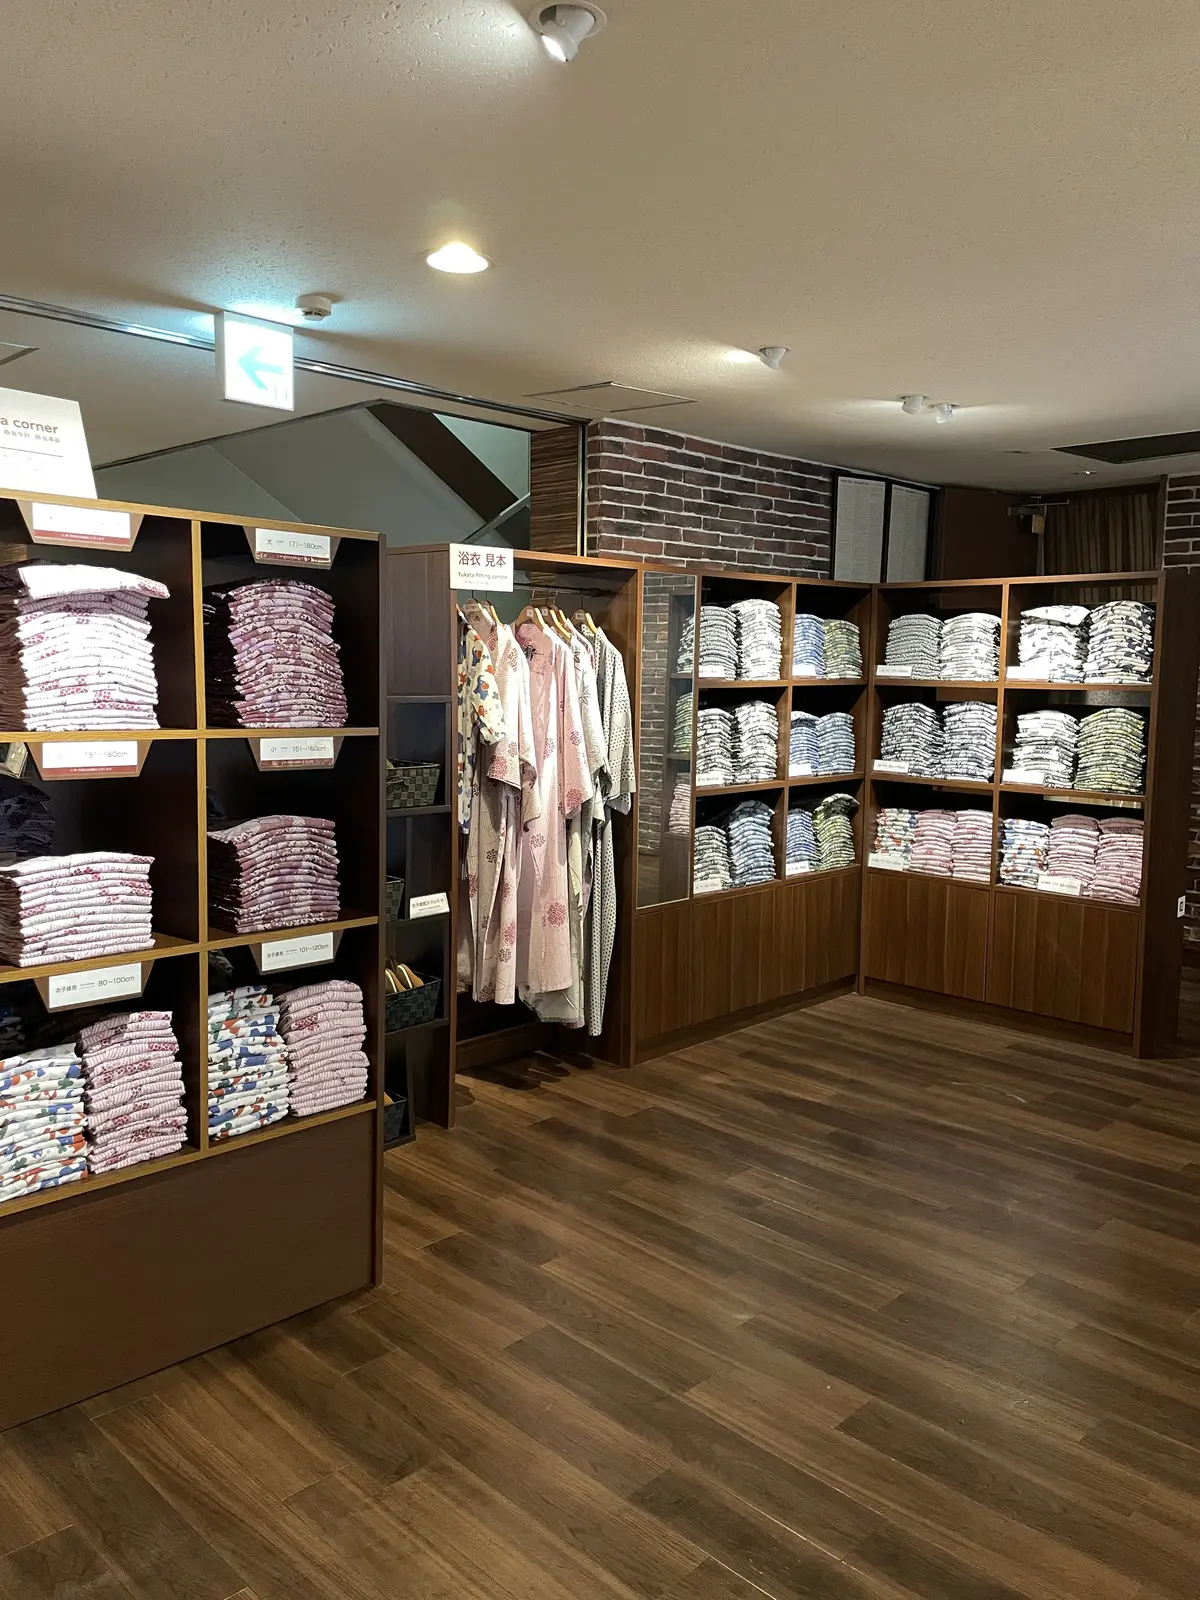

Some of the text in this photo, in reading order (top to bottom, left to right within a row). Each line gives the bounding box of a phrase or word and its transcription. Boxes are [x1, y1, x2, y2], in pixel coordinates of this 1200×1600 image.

[13, 419, 59, 434] corner
[458, 550, 507, 568] 浴衣 見本
